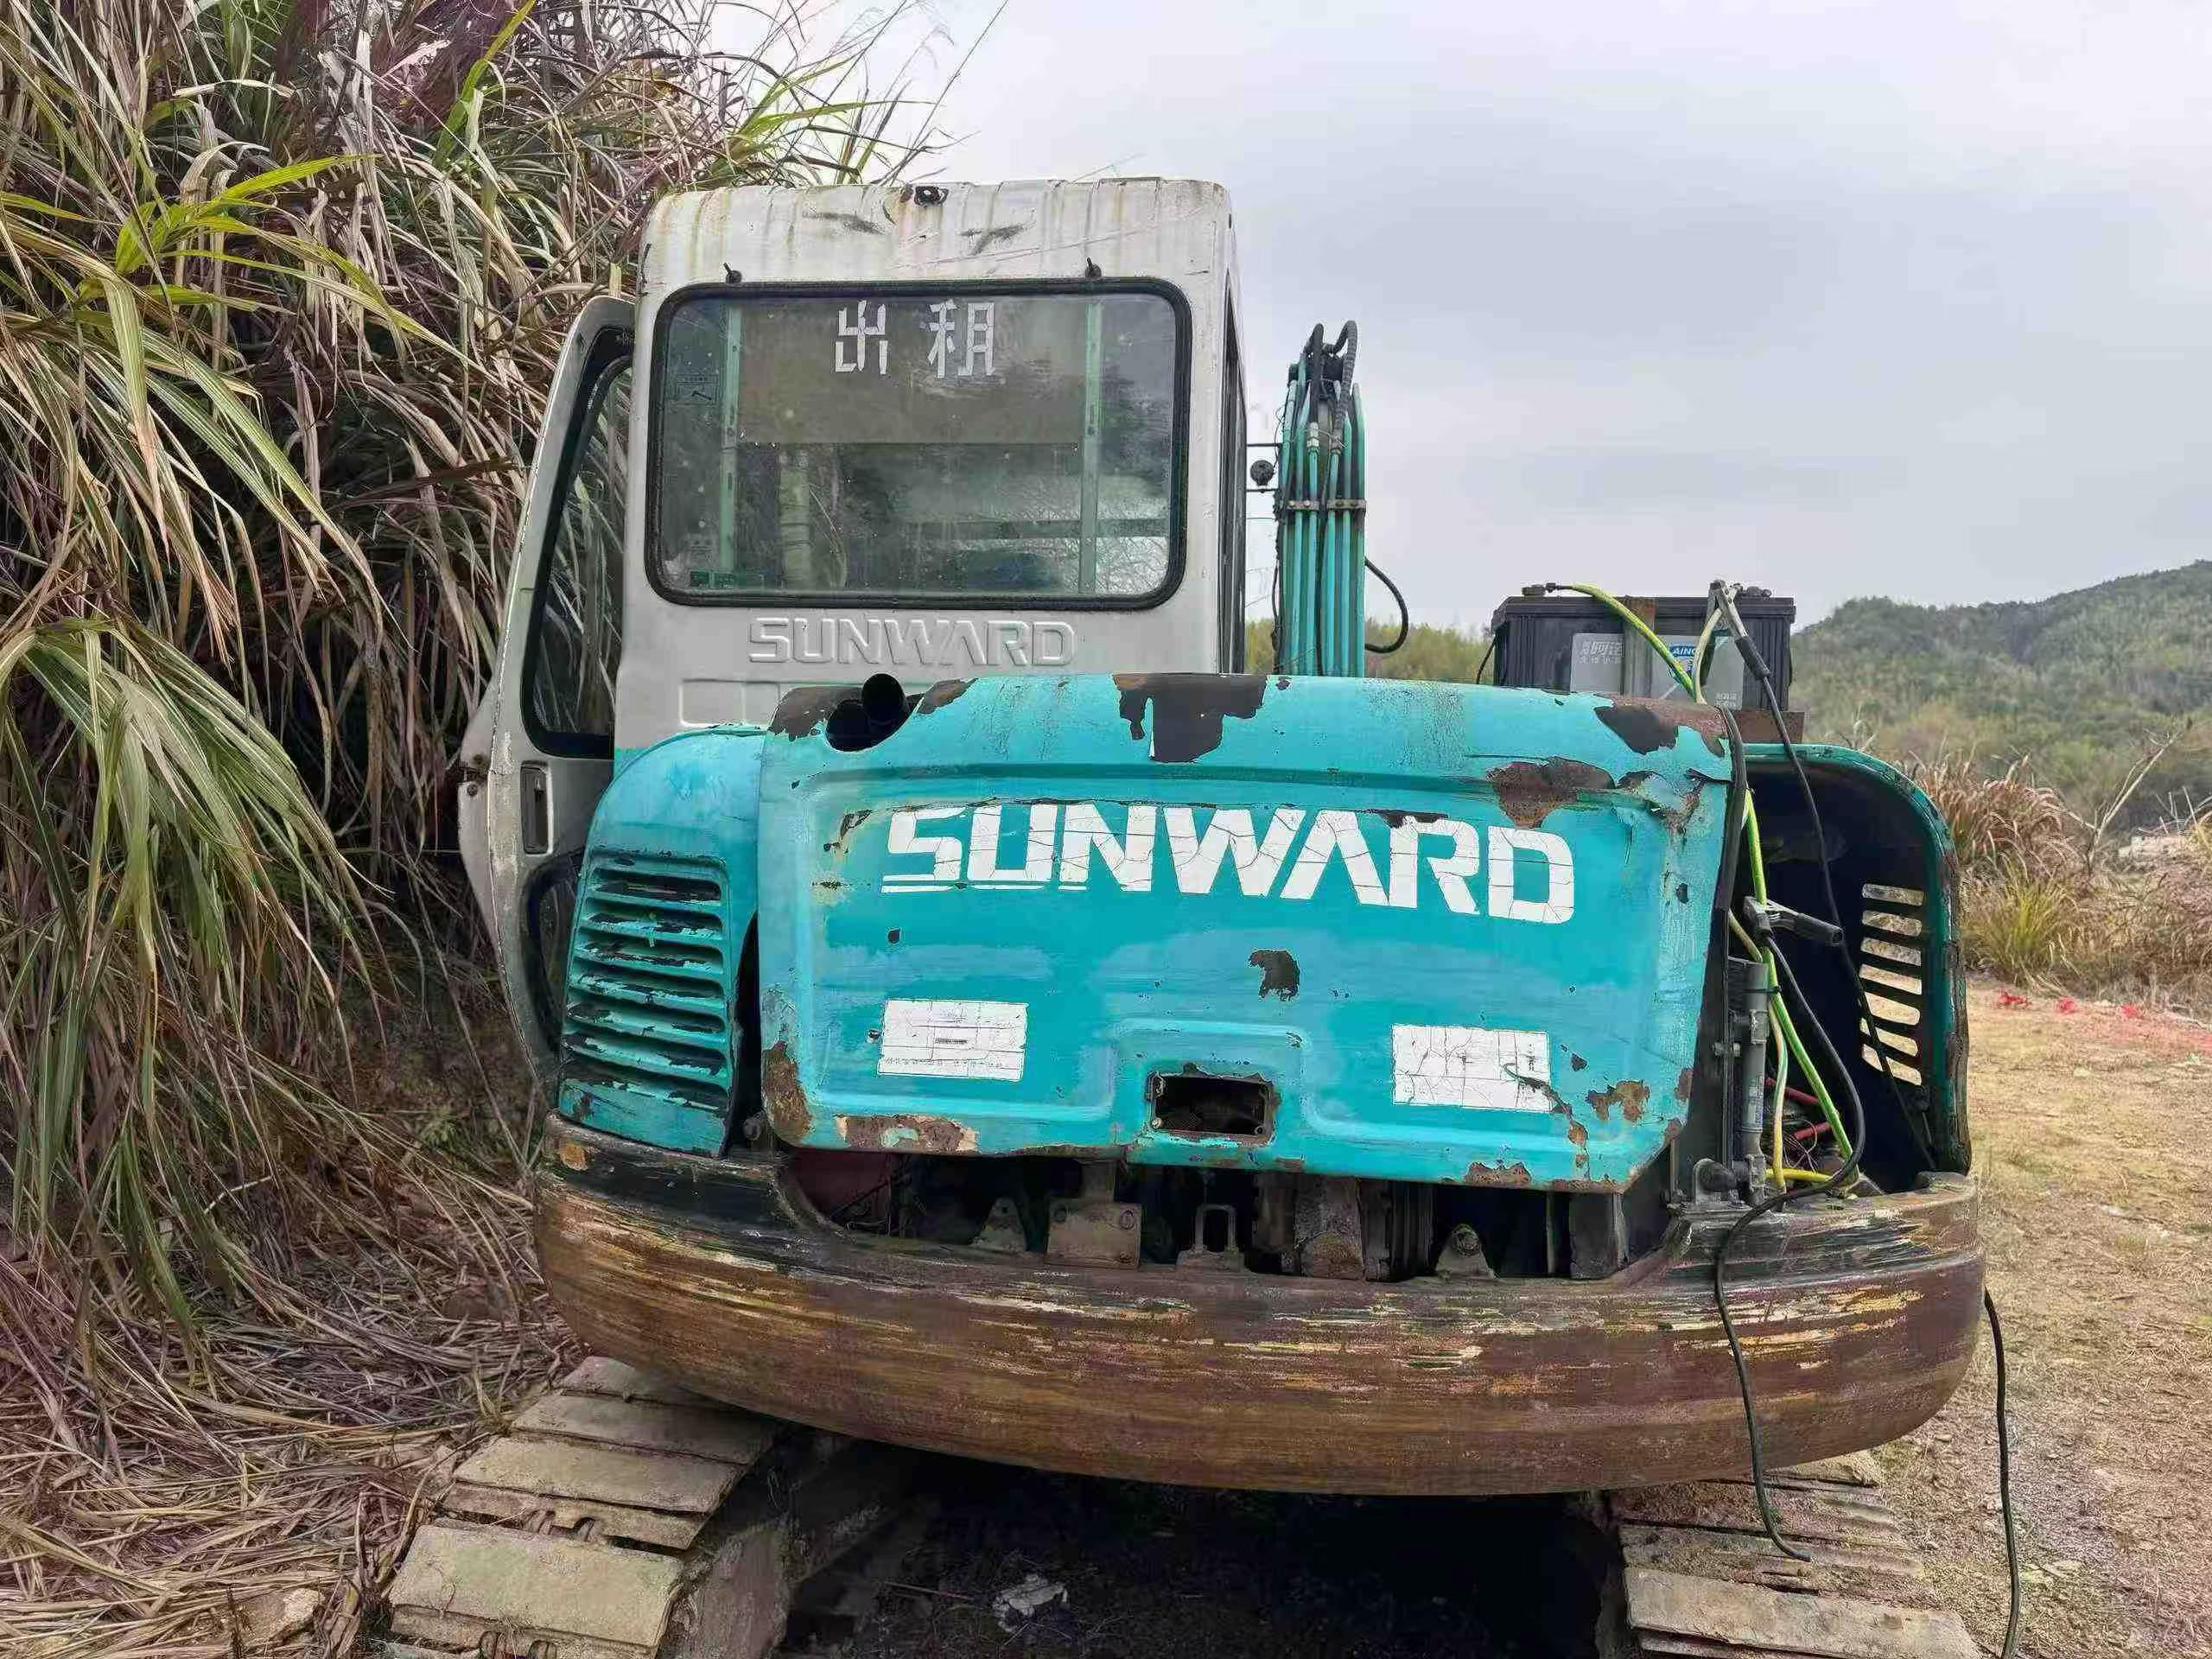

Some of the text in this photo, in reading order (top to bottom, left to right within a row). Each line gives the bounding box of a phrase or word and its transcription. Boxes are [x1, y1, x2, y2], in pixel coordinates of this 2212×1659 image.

[836, 300, 995, 378] 出租
[748, 617, 1077, 667] SUNWARD
[880, 801, 1575, 925] SUNWARD
